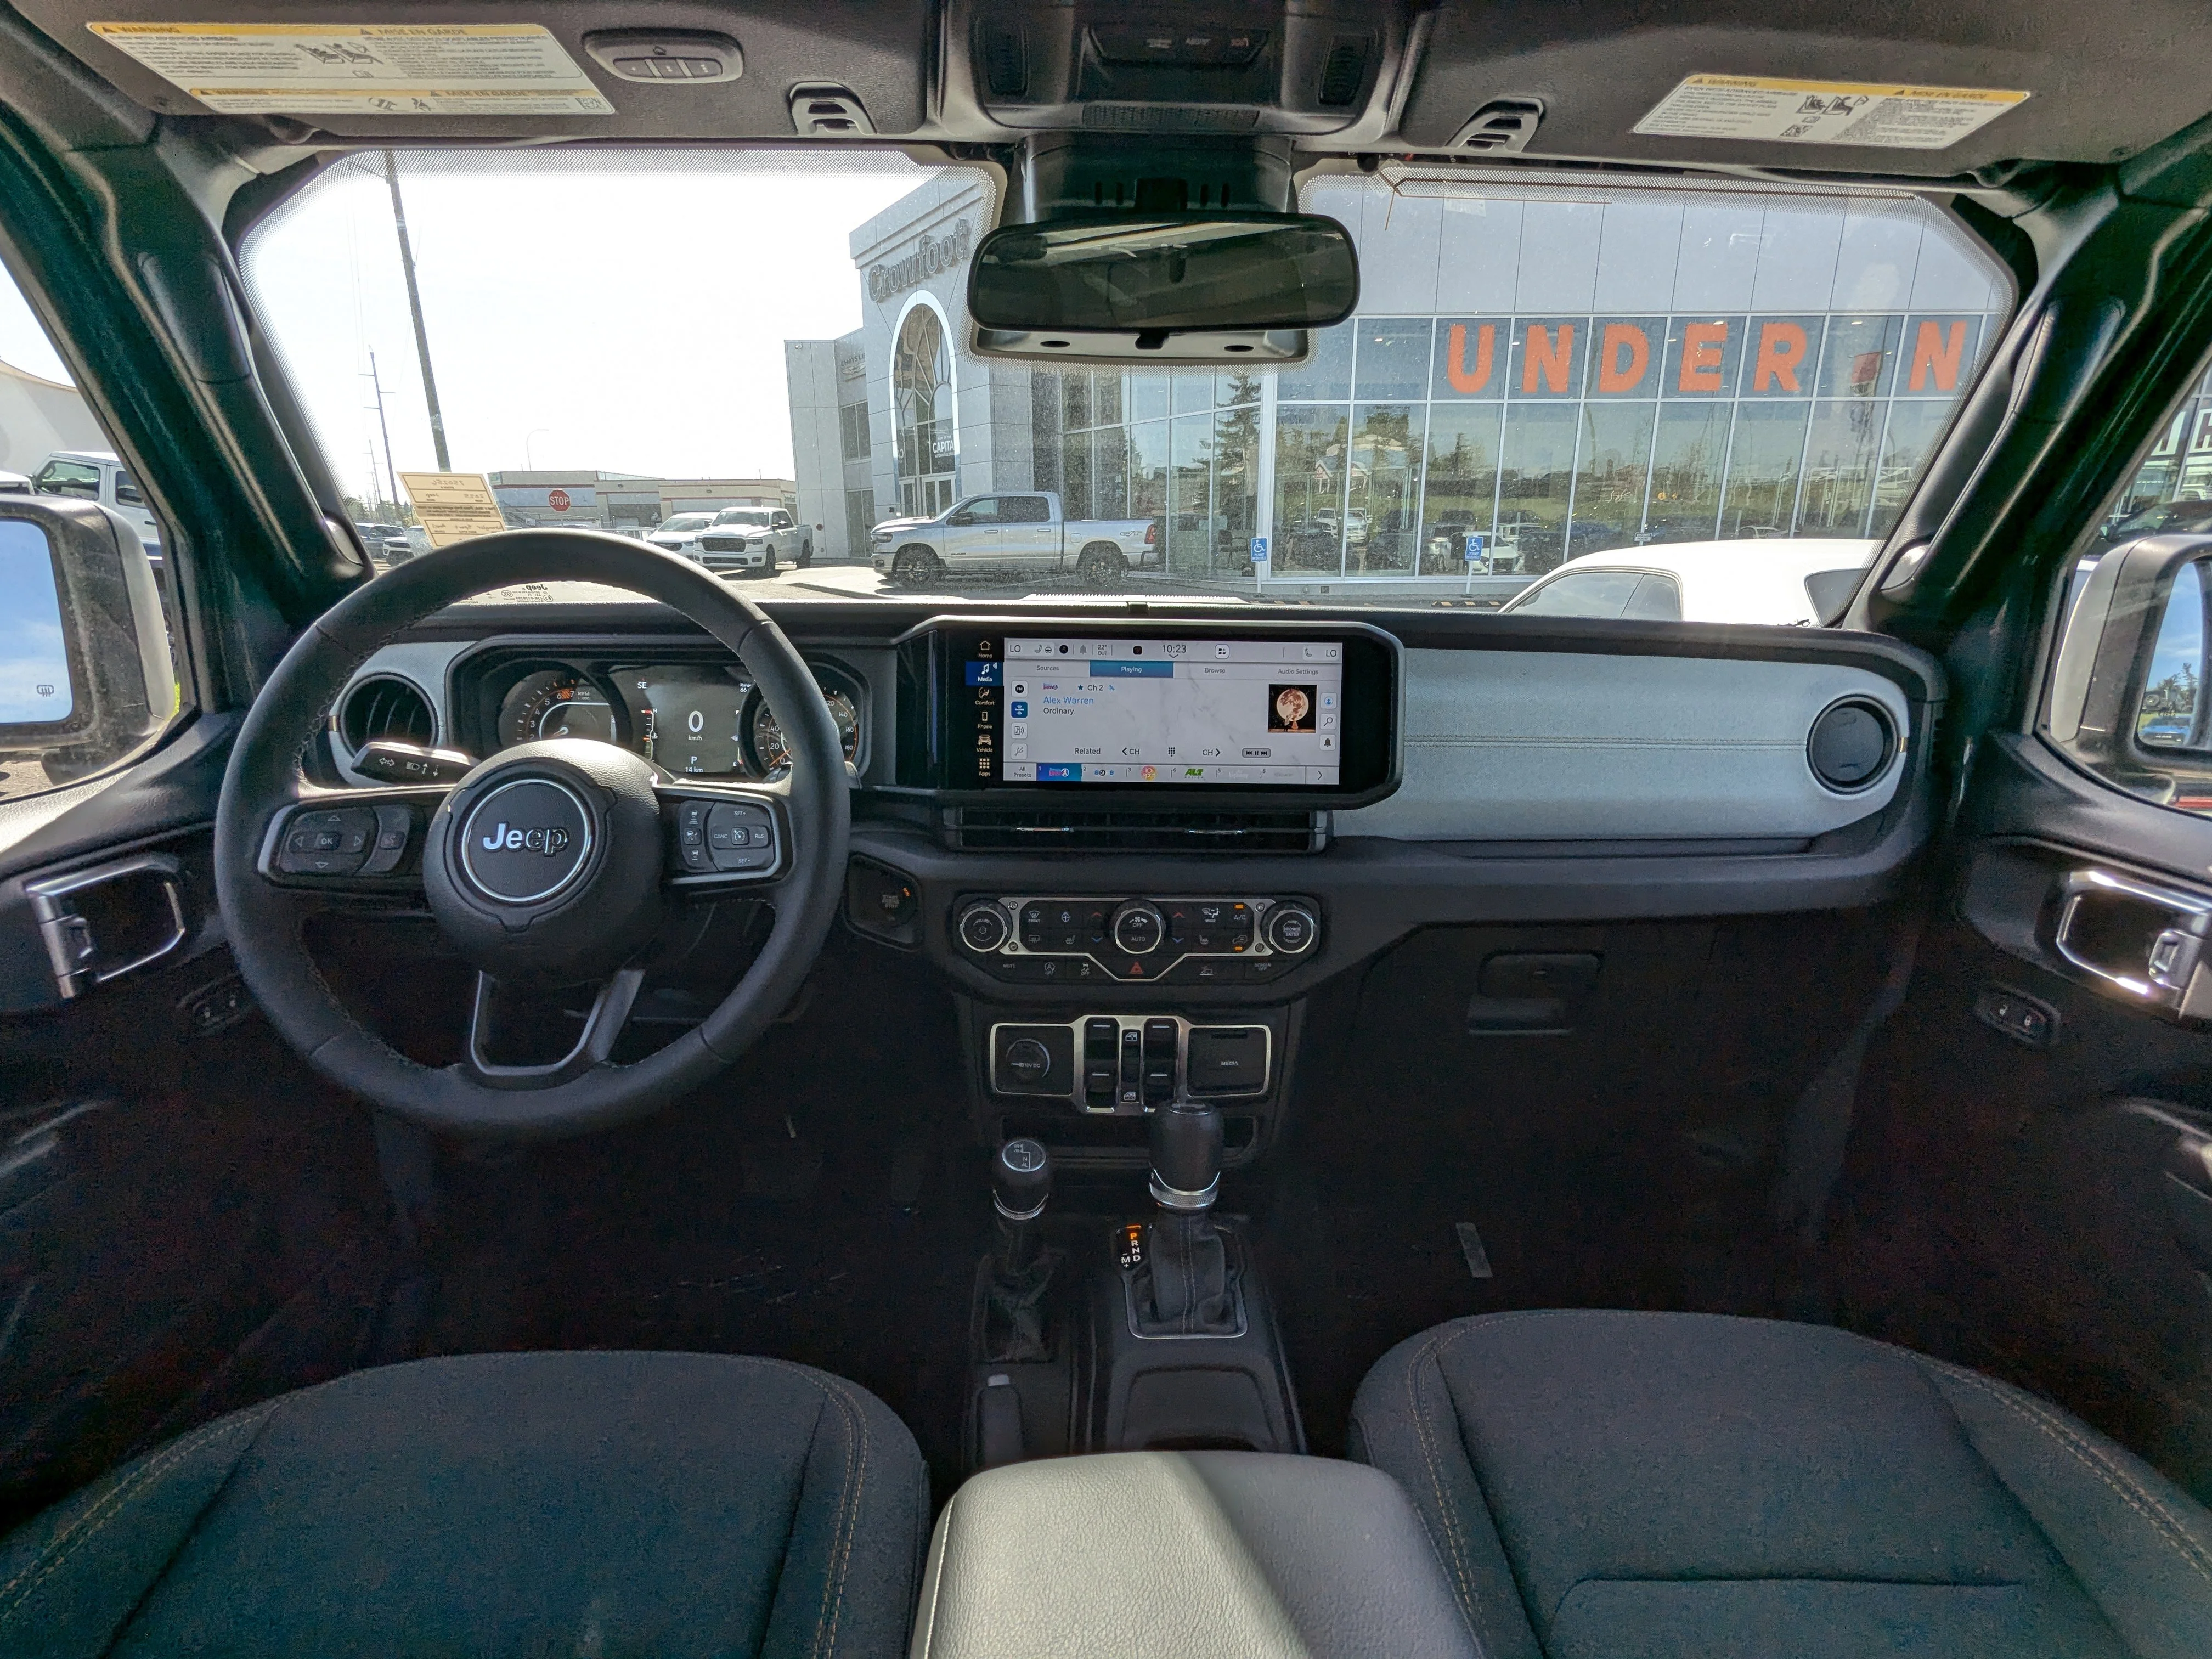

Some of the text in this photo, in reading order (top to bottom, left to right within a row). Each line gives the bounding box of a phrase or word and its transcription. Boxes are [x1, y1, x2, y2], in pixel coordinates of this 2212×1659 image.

[868, 218, 969, 302] Crowfoot
[841, 353, 865, 366] CHRYSLE
[1447, 323, 1808, 394] UNDER
[550, 496, 569, 505] STOP
[1161, 645, 1187, 653] 10:23
[1043, 696, 1094, 704] Alex Warren
[1043, 707, 1074, 715] Ordinary
[688, 710, 704, 732] 0
[483, 822, 568, 855] Jeep
